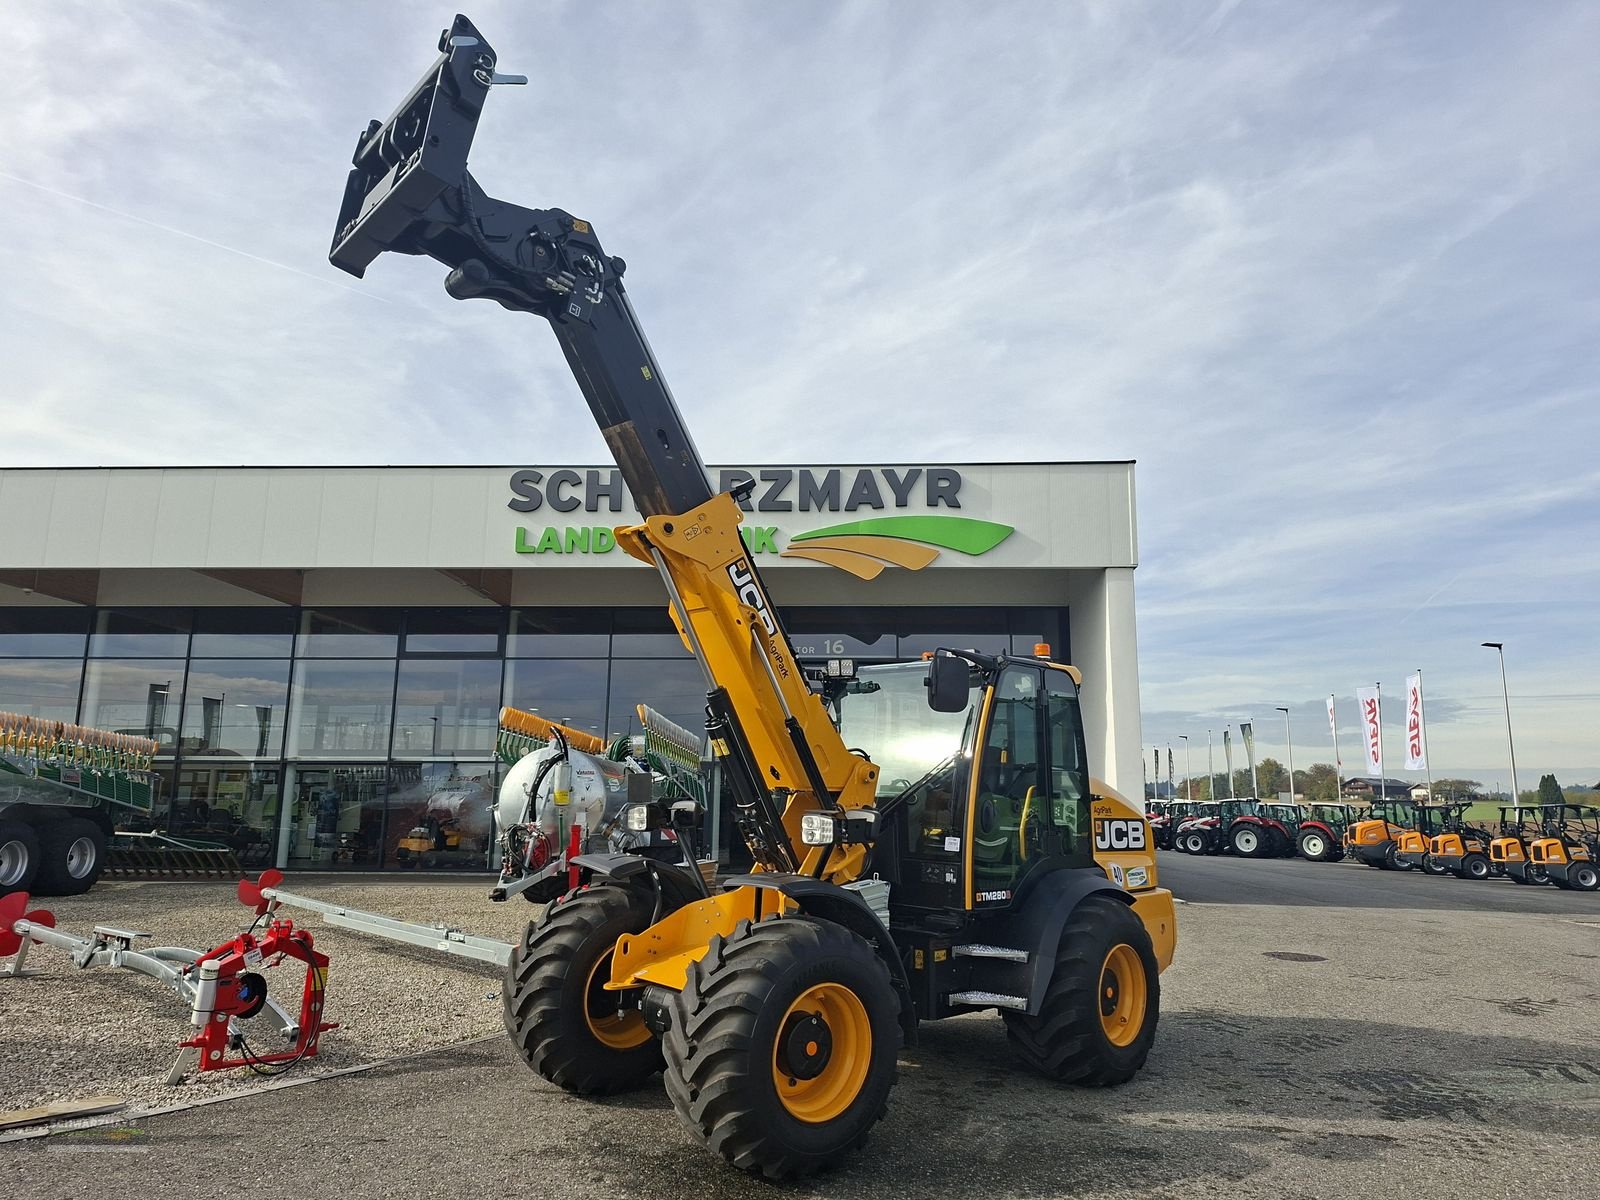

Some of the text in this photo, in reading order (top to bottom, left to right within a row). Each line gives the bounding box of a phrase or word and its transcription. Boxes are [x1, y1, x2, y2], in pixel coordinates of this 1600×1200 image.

[508, 468, 962, 512] SCHRZMAYR
[824, 639, 845, 654] 16
[1095, 820, 1145, 849] JCB
